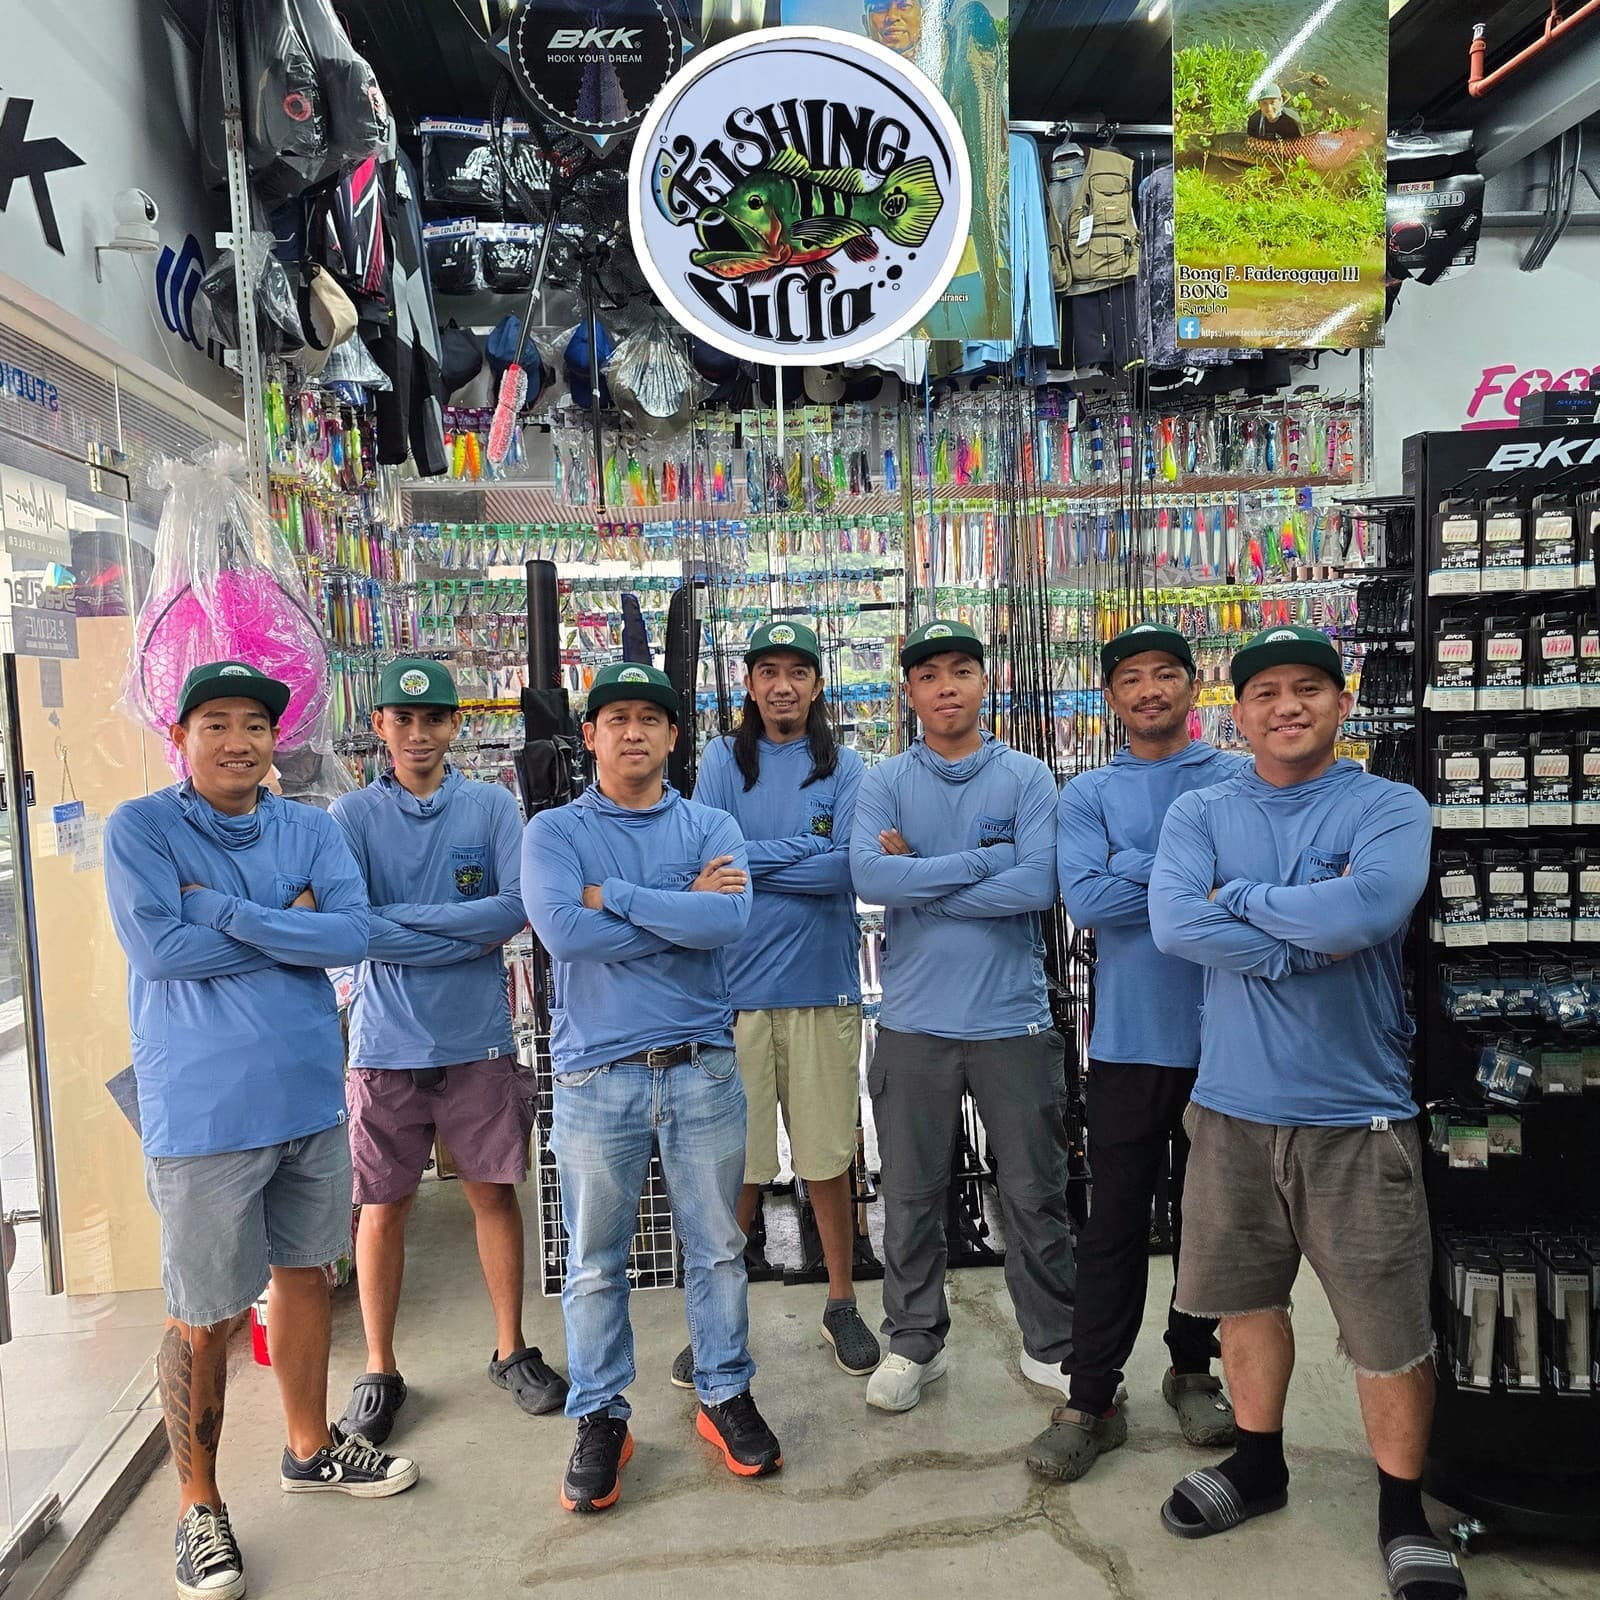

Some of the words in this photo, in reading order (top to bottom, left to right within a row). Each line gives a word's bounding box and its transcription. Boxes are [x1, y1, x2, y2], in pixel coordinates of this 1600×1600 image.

[547, 27, 643, 49] BKK
[547, 54, 575, 63] HOOK
[578, 54, 605, 63] YOUR
[608, 54, 643, 63] DREAM
[449, 123, 482, 134] COVER
[667, 97, 911, 214] FISHING
[1179, 265, 1222, 283] Bong
[1225, 266, 1240, 281] F.
[1244, 265, 1339, 285] Faderogaya
[1341, 266, 1359, 281] III
[1179, 284, 1229, 300] BONG
[684, 271, 877, 344] Villa
[1543, 676, 1577, 684] FLASH
[1446, 914, 1480, 923] FLASH
